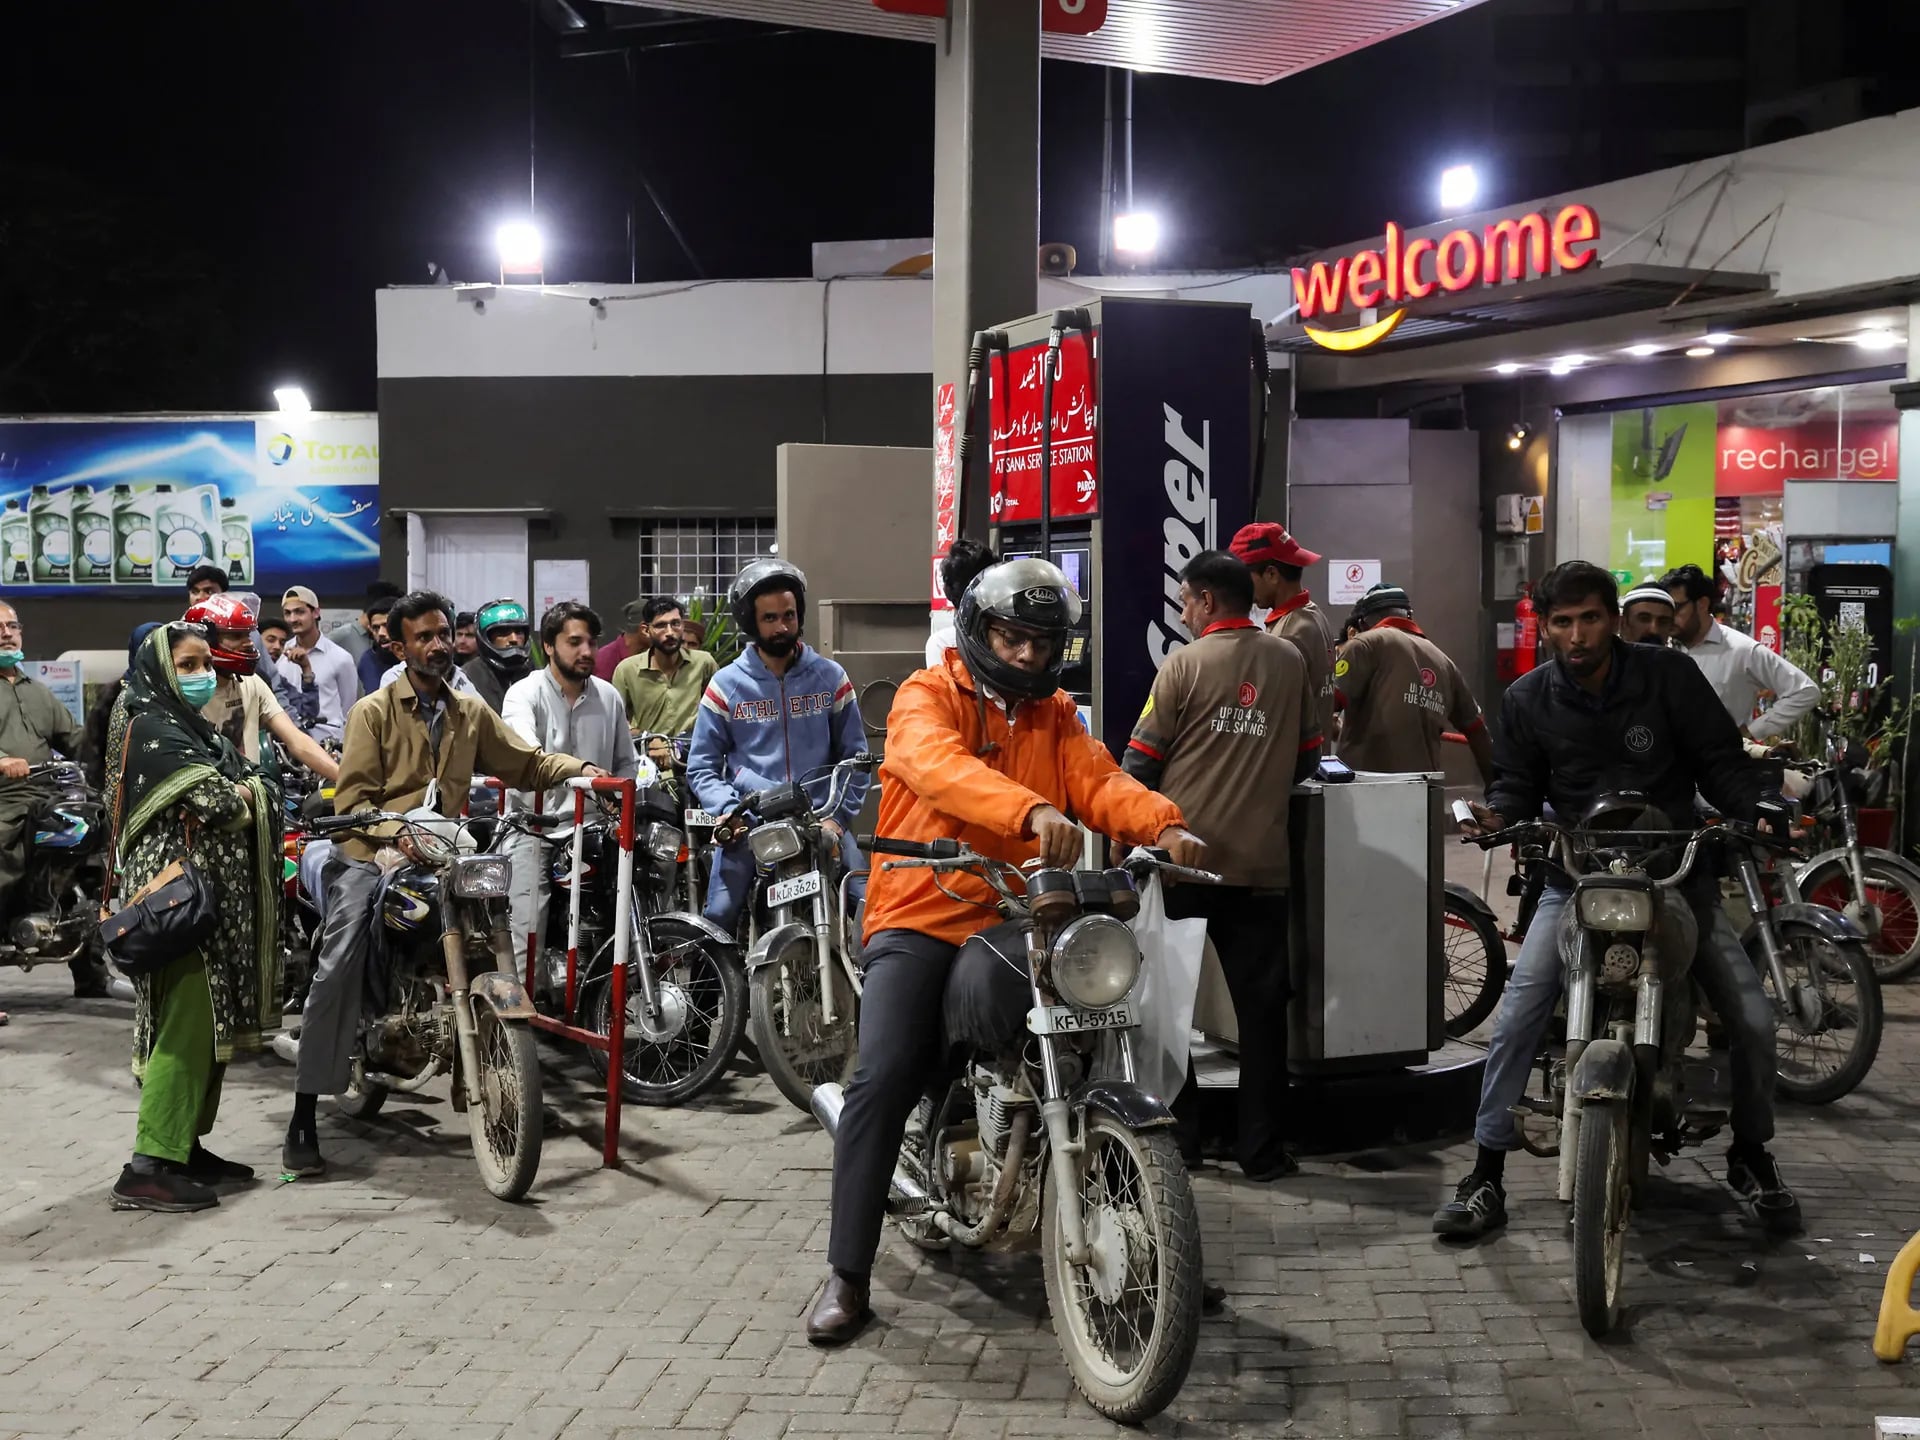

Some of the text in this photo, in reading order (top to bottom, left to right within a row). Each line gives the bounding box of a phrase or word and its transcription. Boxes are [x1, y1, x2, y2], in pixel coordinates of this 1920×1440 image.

[1291, 204, 1599, 318] welcome
[995, 458, 1005, 474] AT
[1006, 455, 1026, 473] SANA
[1059, 444, 1093, 465] STATION
[1722, 441, 1888, 474] recharge!
[1077, 480, 1095, 492] PARCO
[1220, 707, 1233, 719] UP
[1233, 707, 1243, 720] TO
[1055, 1010, 1127, 1030] KFV-5915
